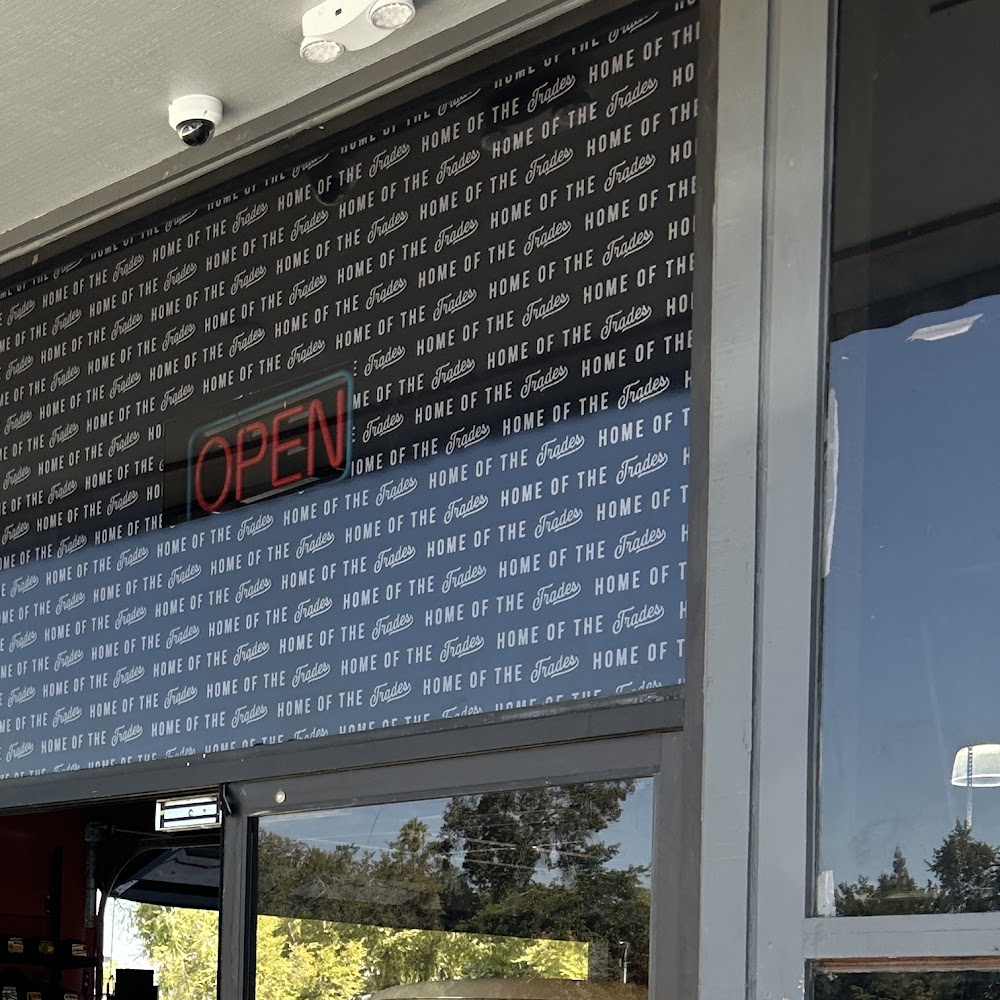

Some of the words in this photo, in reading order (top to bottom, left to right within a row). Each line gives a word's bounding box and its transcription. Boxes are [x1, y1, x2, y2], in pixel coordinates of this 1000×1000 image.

[6, 299, 35, 326] Trades
[42, 285, 68, 308] HOME
[73, 278, 84, 295] OF
[89, 268, 107, 289] THE
[112, 254, 144, 282] Trades
[152, 237, 182, 263] HOME
[187, 230, 200, 248] OF
[206, 219, 226, 240] THE
[231, 202, 268, 233] Trades
[278, 183, 311, 211] HOME
[317, 175, 332, 194] OF
[338, 162, 362, 186] THE
[368, 143, 410, 178] Trades
[421, 122, 460, 153] HOME
[467, 111, 484, 133] OF
[492, 97, 519, 123] THE
[527, 74, 575, 113] Trades
[589, 48, 633, 84] HOME
[643, 36, 663, 60] OF
[4, 410, 32, 435] Trades
[39, 398, 65, 420] HOME
[69, 392, 81, 409] OF
[86, 384, 104, 403] THE
[109, 371, 141, 399] Trades
[149, 358, 179, 382] HOME
[184, 351, 197, 369] OF
[202, 342, 223, 363] THE
[229, 328, 265, 358] Trades
[275, 312, 308, 338] HOME
[314, 304, 329, 324] OF
[335, 294, 358, 317] THE
[365, 278, 407, 310] Trades
[418, 259, 456, 288] HOME
[464, 251, 480, 272] OF
[488, 239, 515, 263] THE
[523, 220, 571, 256] Trades
[585, 198, 630, 231] HOME
[639, 188, 658, 212] OF
[363, 345, 405, 376] Trades
[416, 329, 454, 356] HOME
[462, 321, 479, 341] OF
[486, 310, 514, 334] THE
[521, 293, 570, 327] Trades
[583, 273, 627, 304] HOME
[637, 264, 656, 287] OF
[10, 575, 39, 598] Trades
[46, 566, 72, 585] HOME
[76, 561, 88, 578] OF
[93, 556, 111, 574] THE
[116, 547, 148, 571] Trades
[157, 536, 186, 558] HOME
[192, 531, 205, 549] OF
[210, 525, 231, 544] THE
[237, 514, 274, 541] Trades
[283, 503, 317, 526] HOME
[323, 497, 338, 516] OF
[345, 489, 368, 510] THE
[375, 477, 417, 506] Trades
[429, 463, 468, 489] HOME
[475, 457, 492, 477] OF
[500, 448, 528, 471] THE
[536, 434, 585, 466] Trades
[598, 419, 644, 447] HOME
[653, 412, 672, 433] OF
[195, 388, 345, 512] OPEN
[17, 660, 28, 675] OF
[32, 656, 49, 672] THE
[53, 649, 84, 672] Trades
[91, 641, 119, 661] HOME
[124, 638, 136, 654] OF
[141, 633, 160, 651] THE
[165, 624, 199, 649] Trades
[208, 616, 239, 637] HOME
[245, 612, 259, 629] OF
[265, 606, 287, 625] THE
[293, 596, 332, 623] Trades
[343, 587, 378, 609] HOME
[386, 582, 401, 601] OF
[408, 575, 434, 596] THE
[441, 564, 486, 593] Trades
[499, 553, 540, 578] HOME
[549, 548, 566, 568] OF
[575, 540, 605, 563] THE
[614, 527, 666, 559] Trades
[5, 741, 34, 762] Trades
[41, 736, 67, 754] HOME
[71, 734, 83, 749] OF
[87, 730, 106, 746] THE
[111, 724, 143, 747] Trades
[151, 718, 180, 737] HOME
[186, 715, 199, 732] OF
[204, 711, 225, 728] THE
[231, 704, 268, 728] Trades
[277, 697, 311, 718] HOME
[317, 694, 332, 711] OF
[338, 689, 362, 708] THE
[369, 681, 411, 707] Trades
[423, 673, 462, 695] HOME
[470, 669, 487, 688] OF
[494, 664, 522, 684] THE
[530, 654, 579, 683] Trades
[593, 645, 638, 670] HOME
[648, 641, 667, 661] OF
